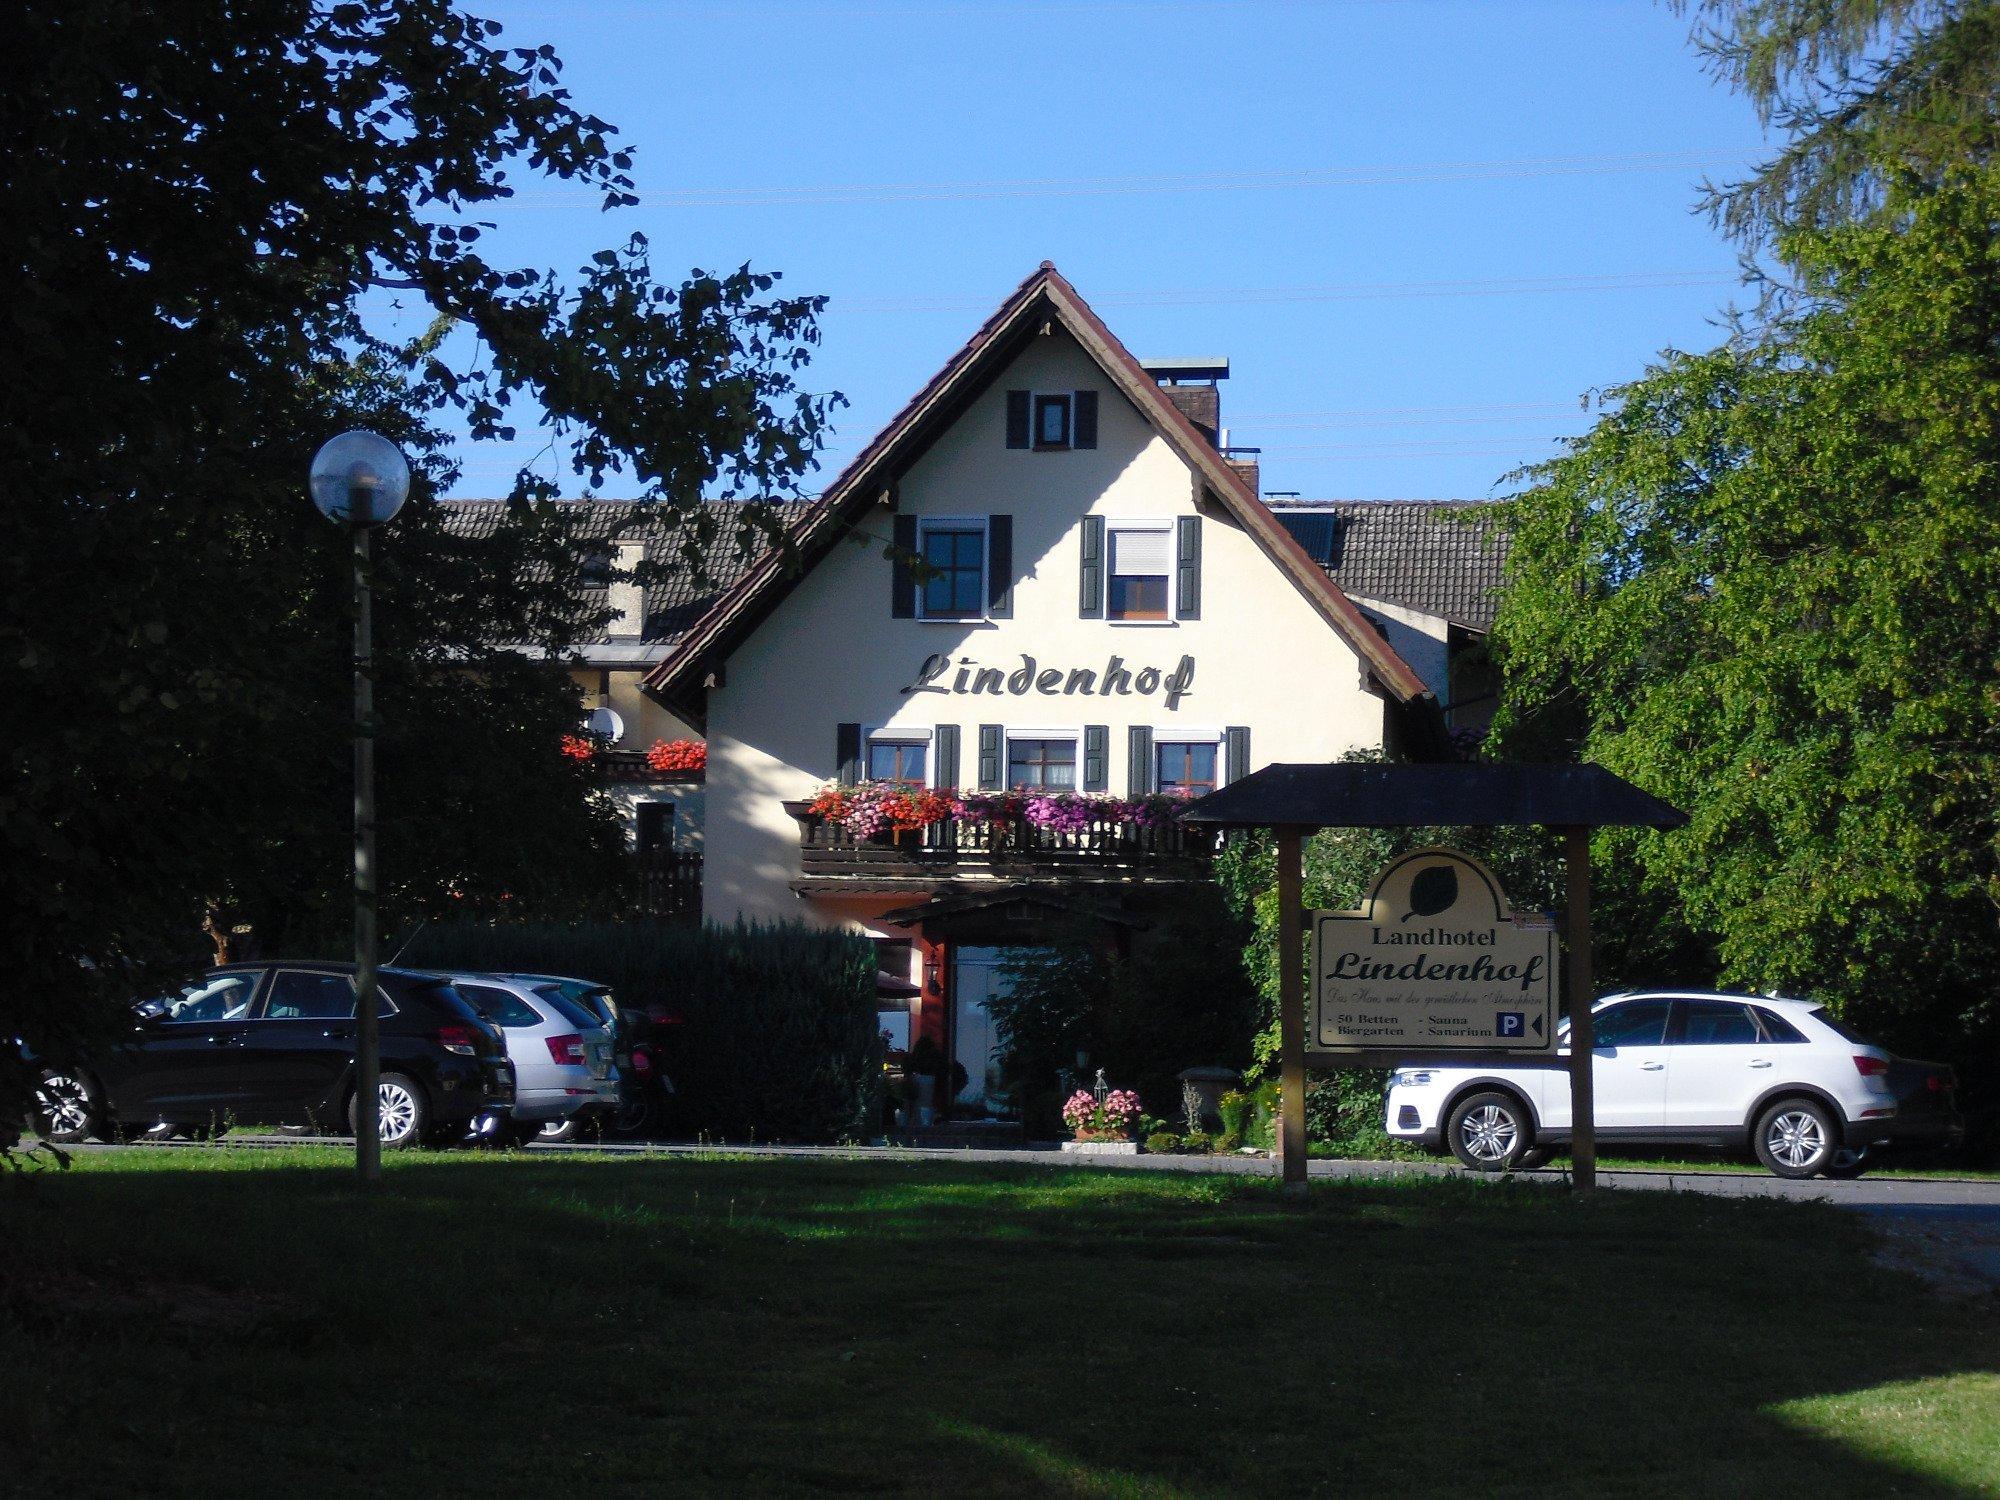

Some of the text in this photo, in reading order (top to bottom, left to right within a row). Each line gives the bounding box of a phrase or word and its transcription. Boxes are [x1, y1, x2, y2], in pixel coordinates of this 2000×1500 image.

[901, 654, 1195, 711] Lindenhof
[1372, 927, 1496, 946] Landhotel
[1326, 952, 1544, 991] Lindenhof
[1338, 1014, 1398, 1024] 50 Betten
[1428, 1015, 1468, 1025] Sauna
[1504, 1016, 1518, 1035] P
[1338, 1026, 1404, 1036] Biergarten
[1428, 1027, 1492, 1037] Sanarium
